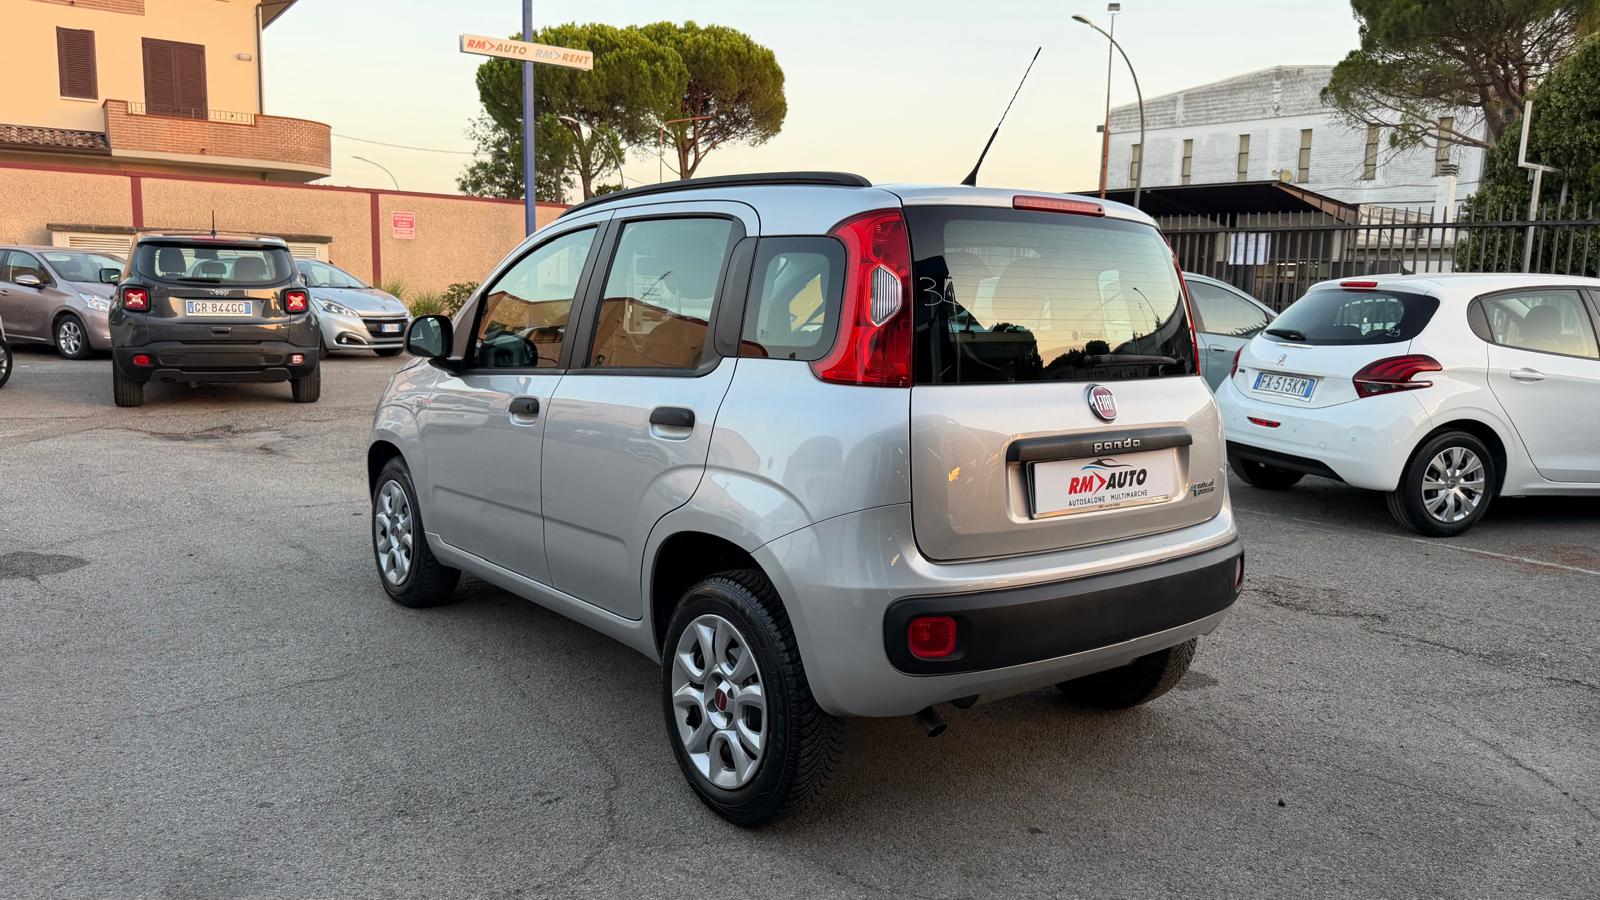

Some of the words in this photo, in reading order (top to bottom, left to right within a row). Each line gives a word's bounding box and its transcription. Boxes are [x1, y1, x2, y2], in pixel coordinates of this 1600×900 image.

[1095, 394, 1116, 411] FIAT
[1093, 438, 1140, 453] panda
[1068, 495, 1106, 507] AUTOSALONE
[1110, 489, 1148, 501] MULTIMARCHE
